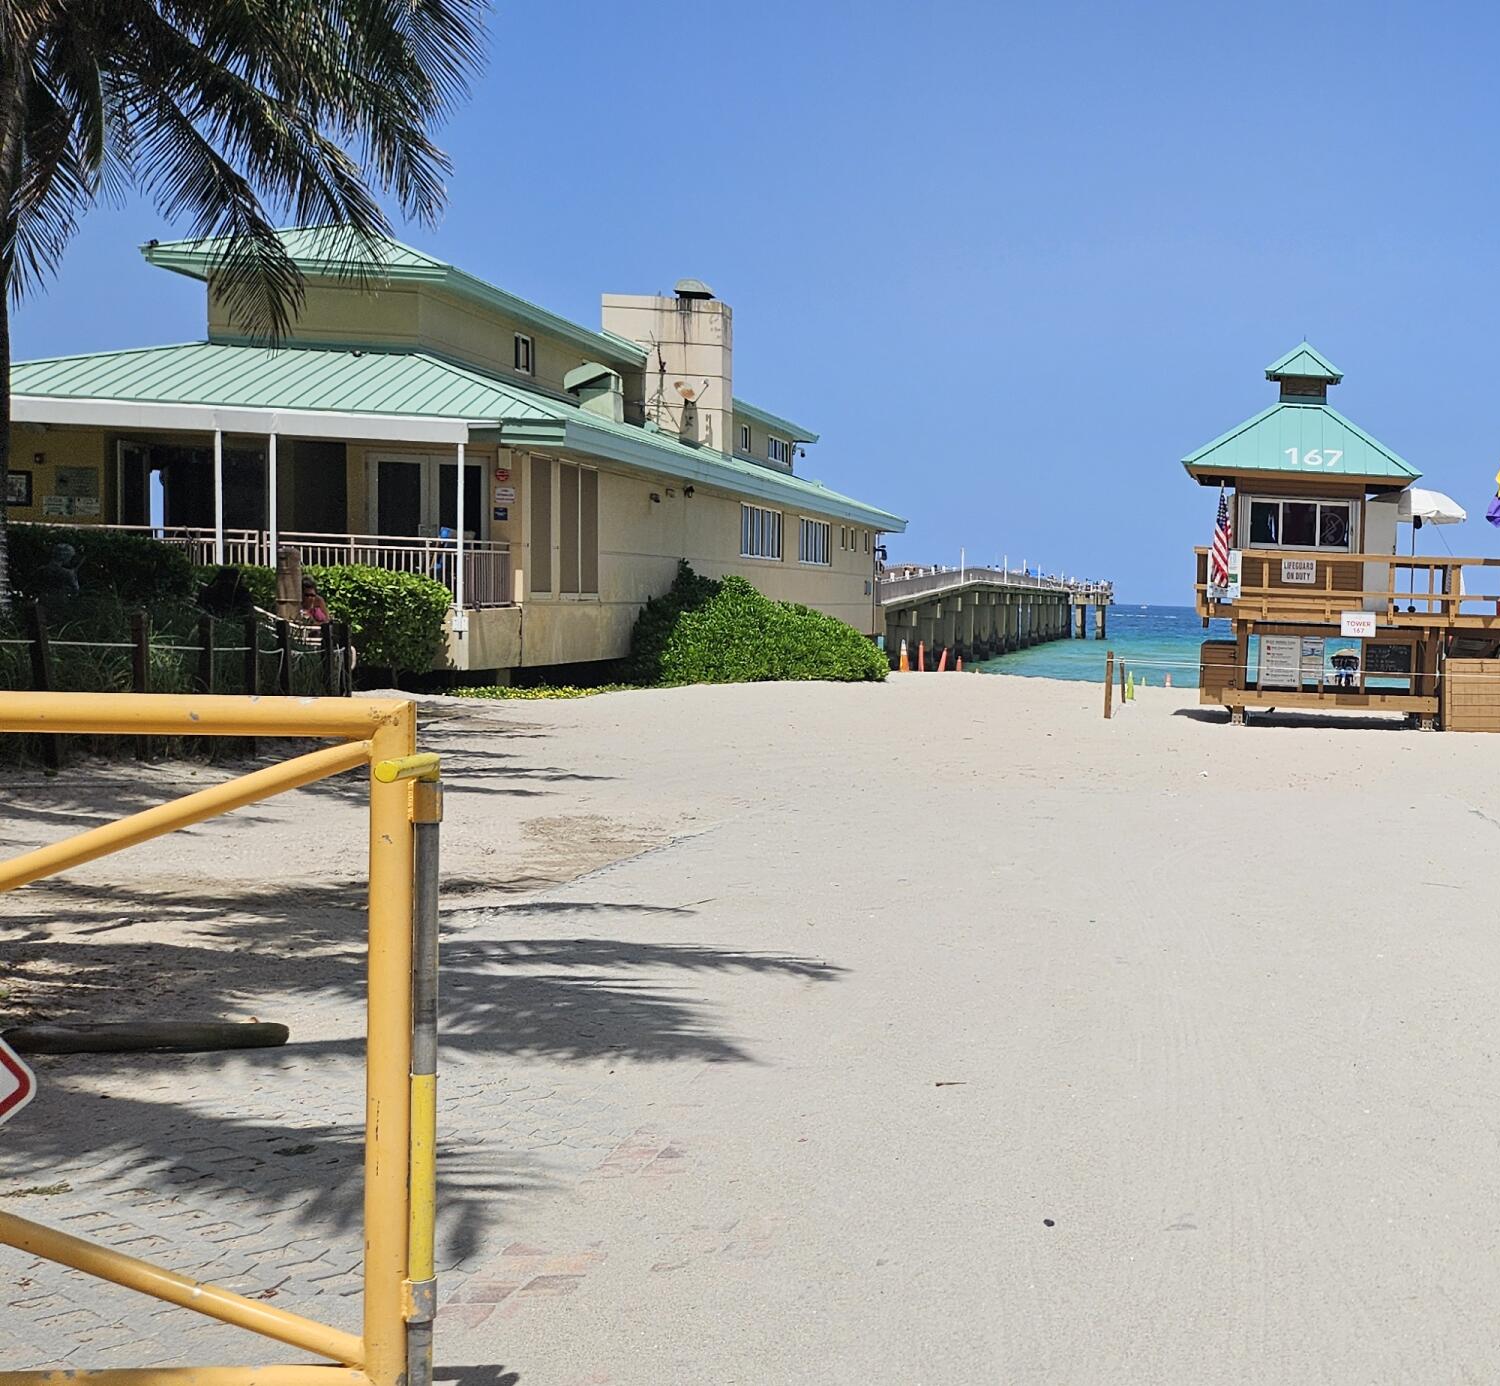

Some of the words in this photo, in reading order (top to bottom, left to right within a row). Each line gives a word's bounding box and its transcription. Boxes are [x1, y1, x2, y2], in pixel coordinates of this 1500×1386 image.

[1284, 447, 1344, 467] 167
[1283, 561, 1314, 571] LIFEGUARD
[1286, 571, 1294, 580] ON
[1295, 572, 1311, 581] DUTY
